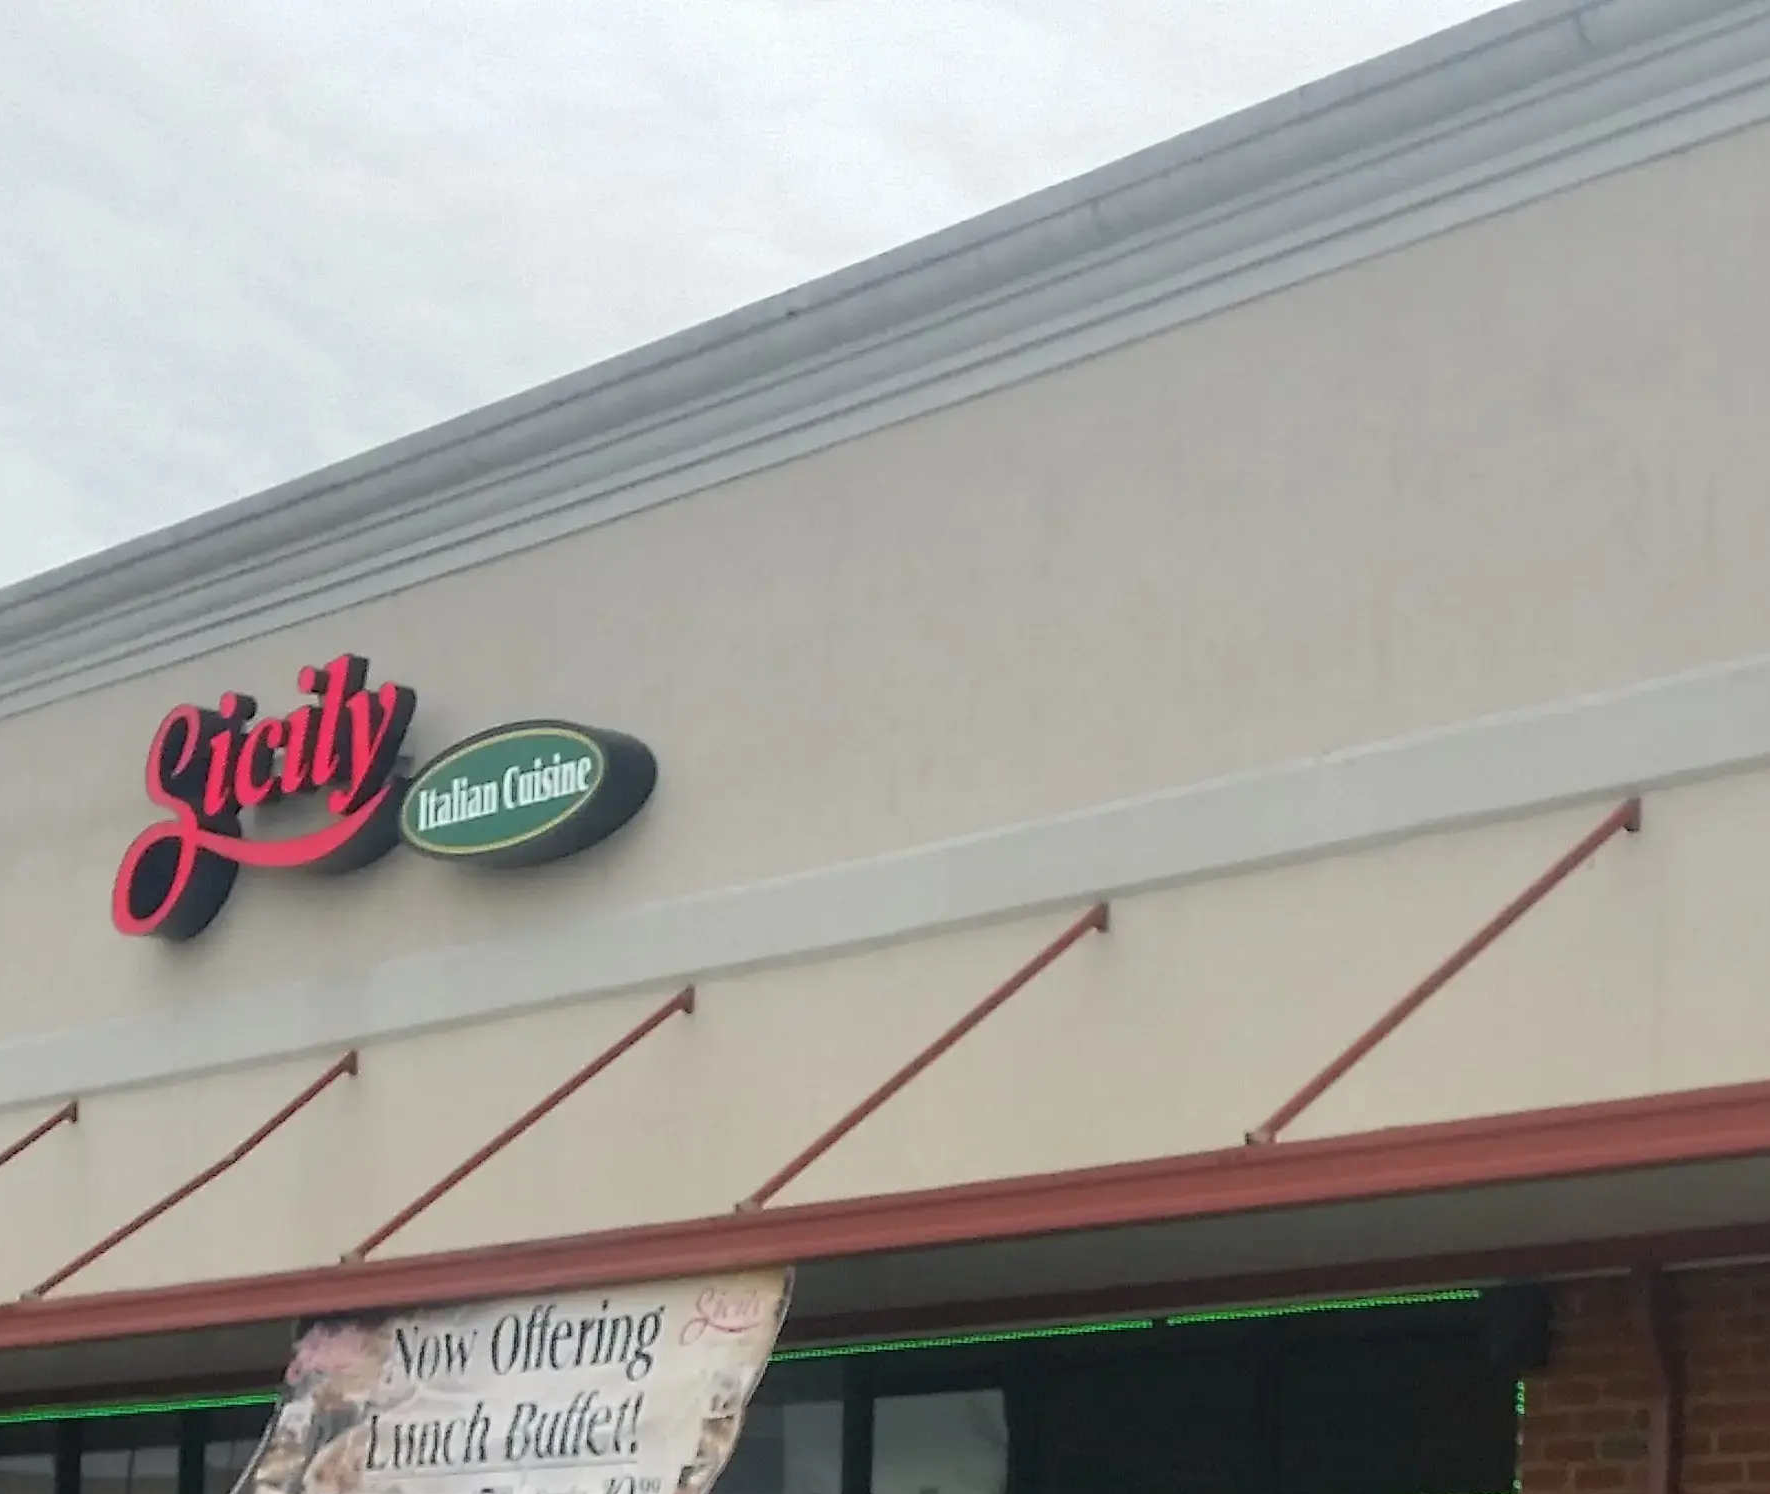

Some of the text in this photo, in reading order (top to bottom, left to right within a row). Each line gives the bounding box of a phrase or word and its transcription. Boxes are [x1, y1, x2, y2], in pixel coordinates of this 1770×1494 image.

[111, 652, 407, 937] Sicily
[416, 752, 594, 833] Italian Cuisine
[384, 1325, 480, 1385] Now
[490, 1299, 666, 1383] Offering
[364, 1390, 646, 1472] Lunch Buffet!
